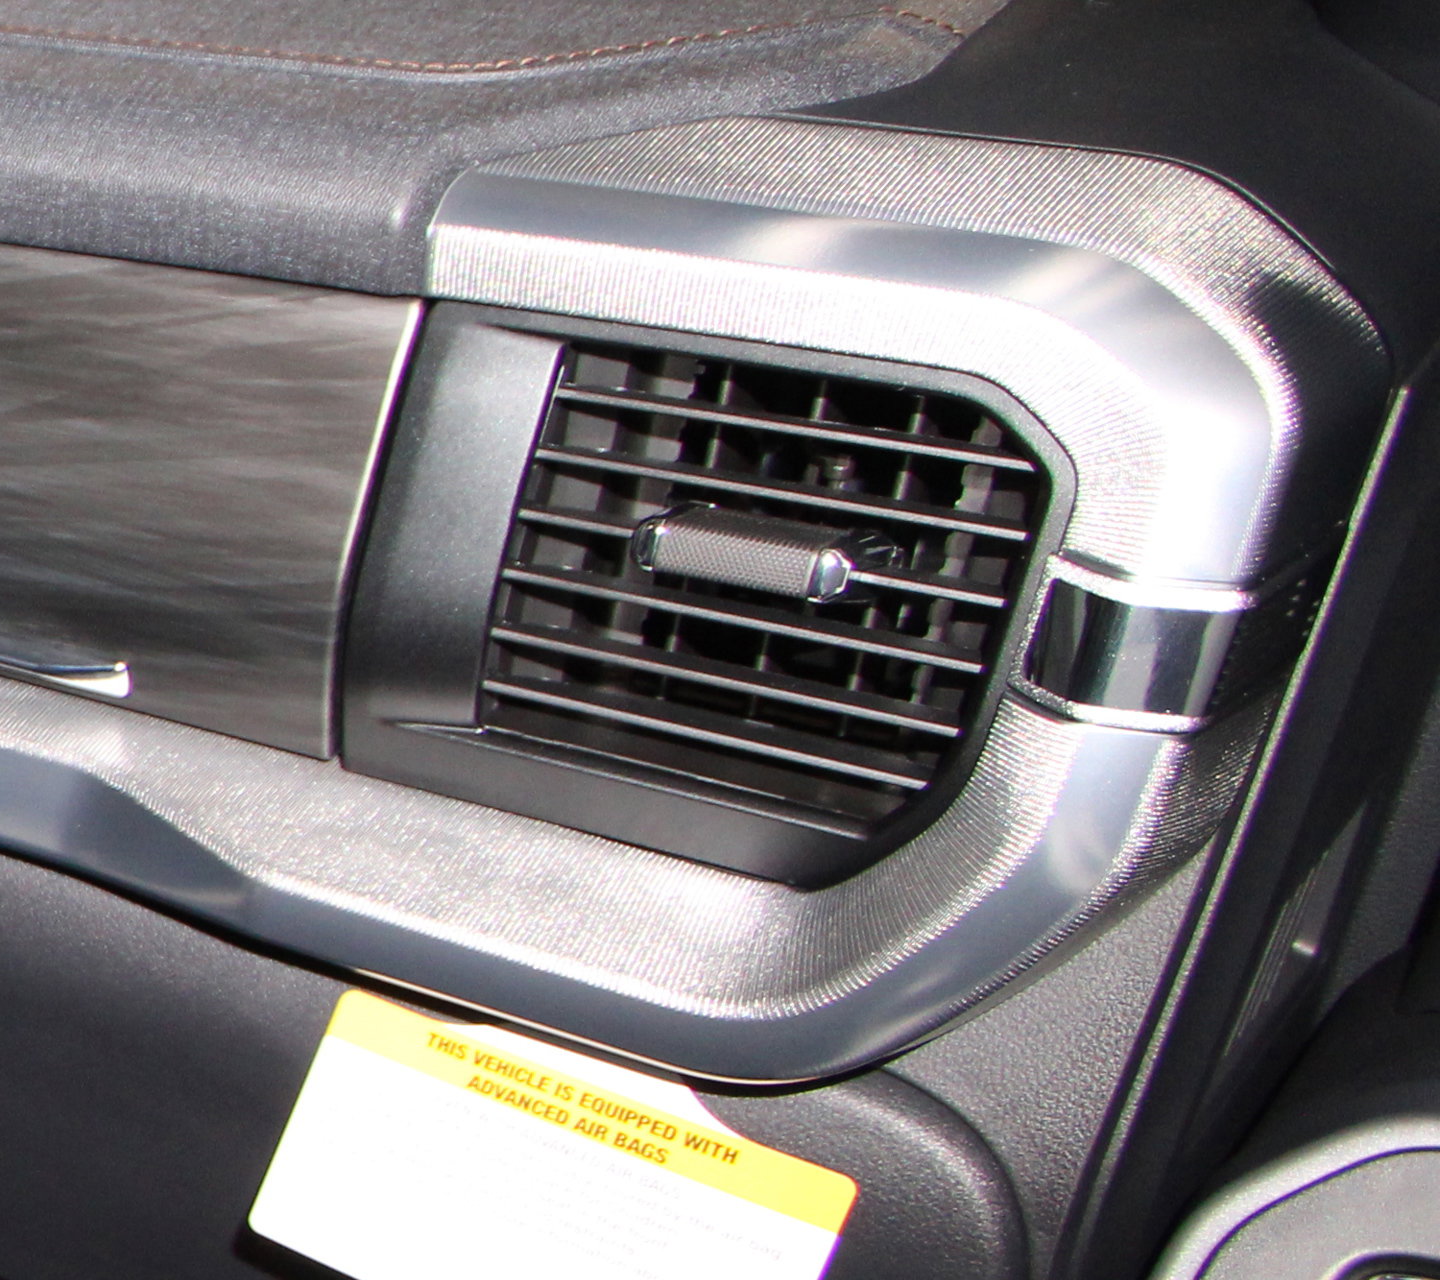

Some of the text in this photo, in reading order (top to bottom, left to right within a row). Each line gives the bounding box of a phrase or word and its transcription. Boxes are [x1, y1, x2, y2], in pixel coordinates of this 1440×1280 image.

[426, 1032, 740, 1165] THIS VEHICLE IS EQUIPPED WITH
[467, 1075, 669, 1165] ADVANCED AIR BAGS
